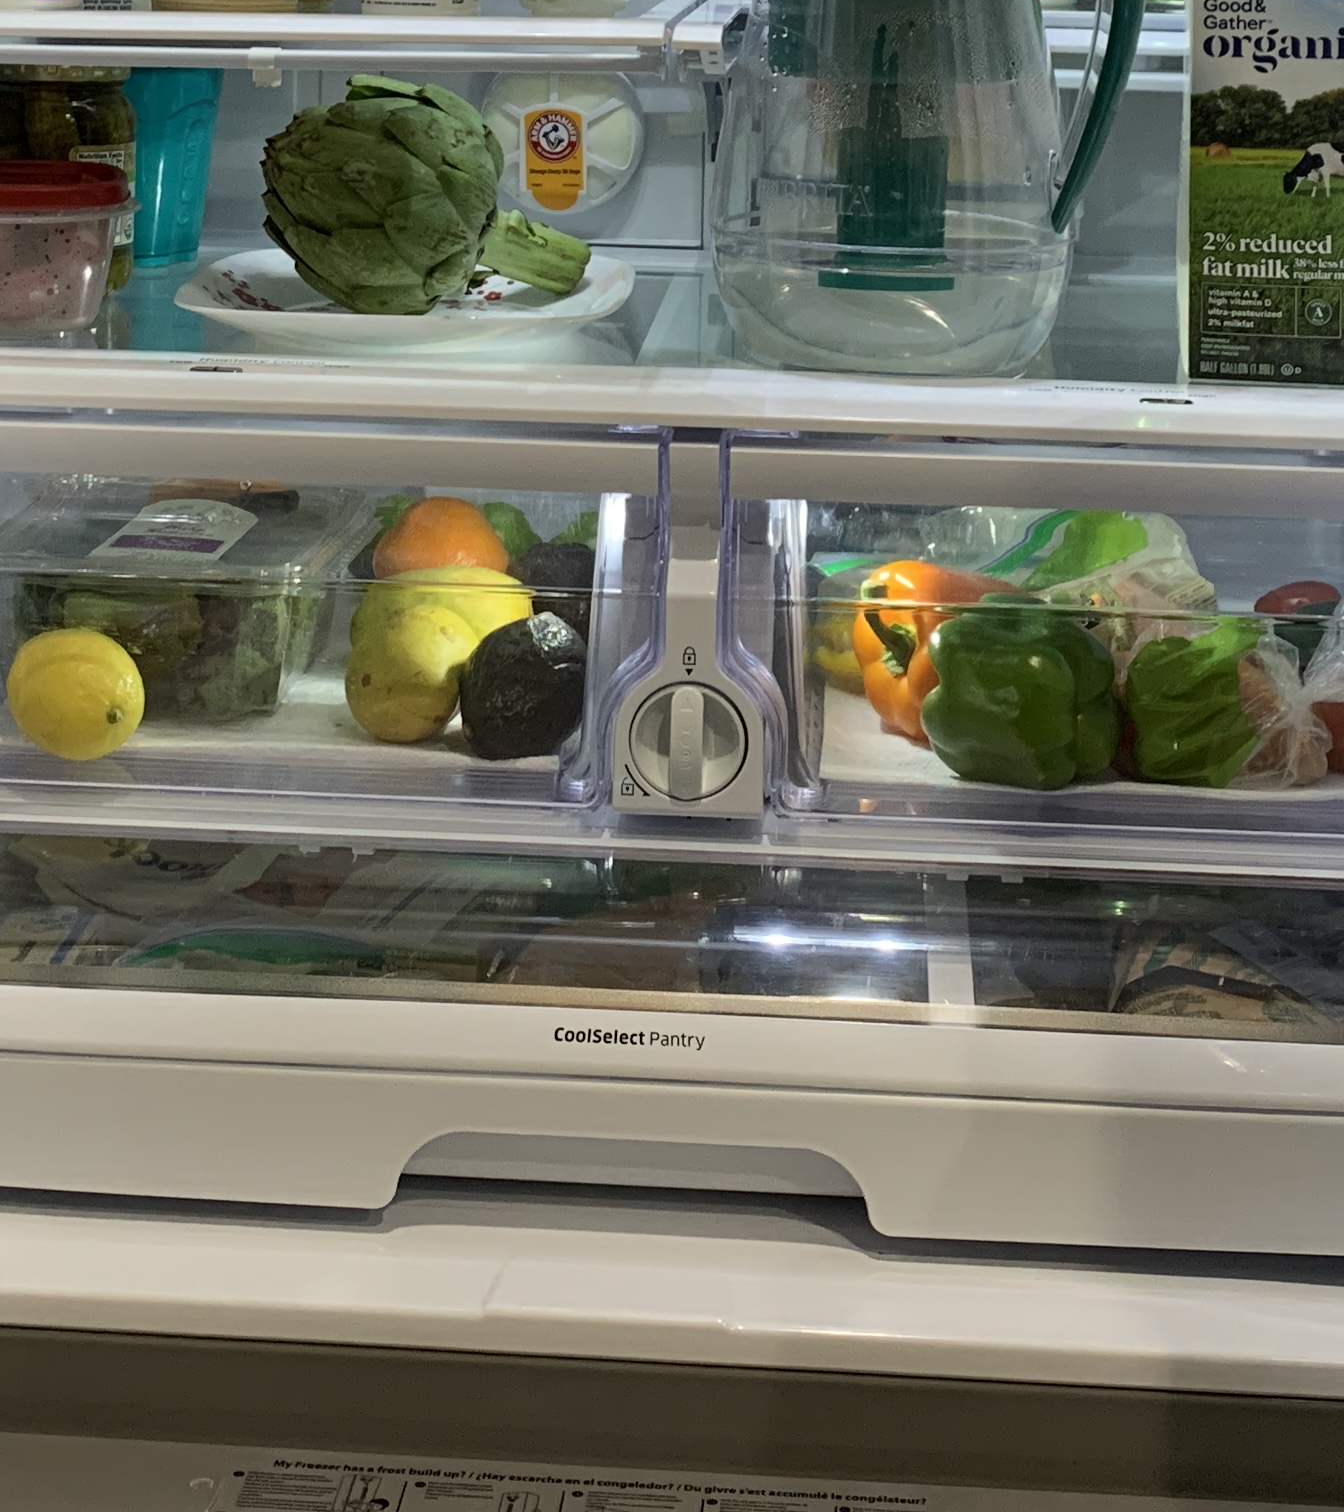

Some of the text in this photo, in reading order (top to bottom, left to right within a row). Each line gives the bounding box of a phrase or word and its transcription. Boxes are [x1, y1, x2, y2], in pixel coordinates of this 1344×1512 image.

[1203, 14, 1266, 31] Gather
[547, 113, 578, 142] HAMMER
[1202, 231, 1333, 255] 2% reduced
[1202, 255, 1291, 280] fat milk
[1293, 257, 1318, 268] 38%
[1318, 259, 1339, 269] less
[1292, 270, 1333, 282] regular
[1208, 289, 1260, 298] vitamin A &
[1208, 297, 1263, 307] high vitamin
[1207, 308, 1283, 319] ultra-pasteurized
[1207, 319, 1255, 329] 2% milkfat
[1199, 360, 1249, 376] HALF GALLON
[553, 1026, 706, 1051] CoolSelect Pantry
[272, 1458, 293, 1471] My
[294, 1460, 340, 1472] Freezer
[342, 1464, 364, 1474] has
[377, 1465, 406, 1476] frost
[409, 1467, 441, 1477] build
[443, 1469, 466, 1481] up?
[475, 1471, 505, 1483] ¿Hay
[508, 1474, 563, 1486] escarcha
[564, 1478, 581, 1486] en
[582, 1477, 595, 1487] el
[597, 1479, 674, 1493] congelador?
[683, 1483, 702, 1493] Du
[704, 1485, 737, 1496] givre
[739, 1486, 767, 1497] s'est
[769, 1489, 828, 1500] accumulé
[830, 1491, 842, 1500] le
[844, 1492, 927, 1506] congélateur?
